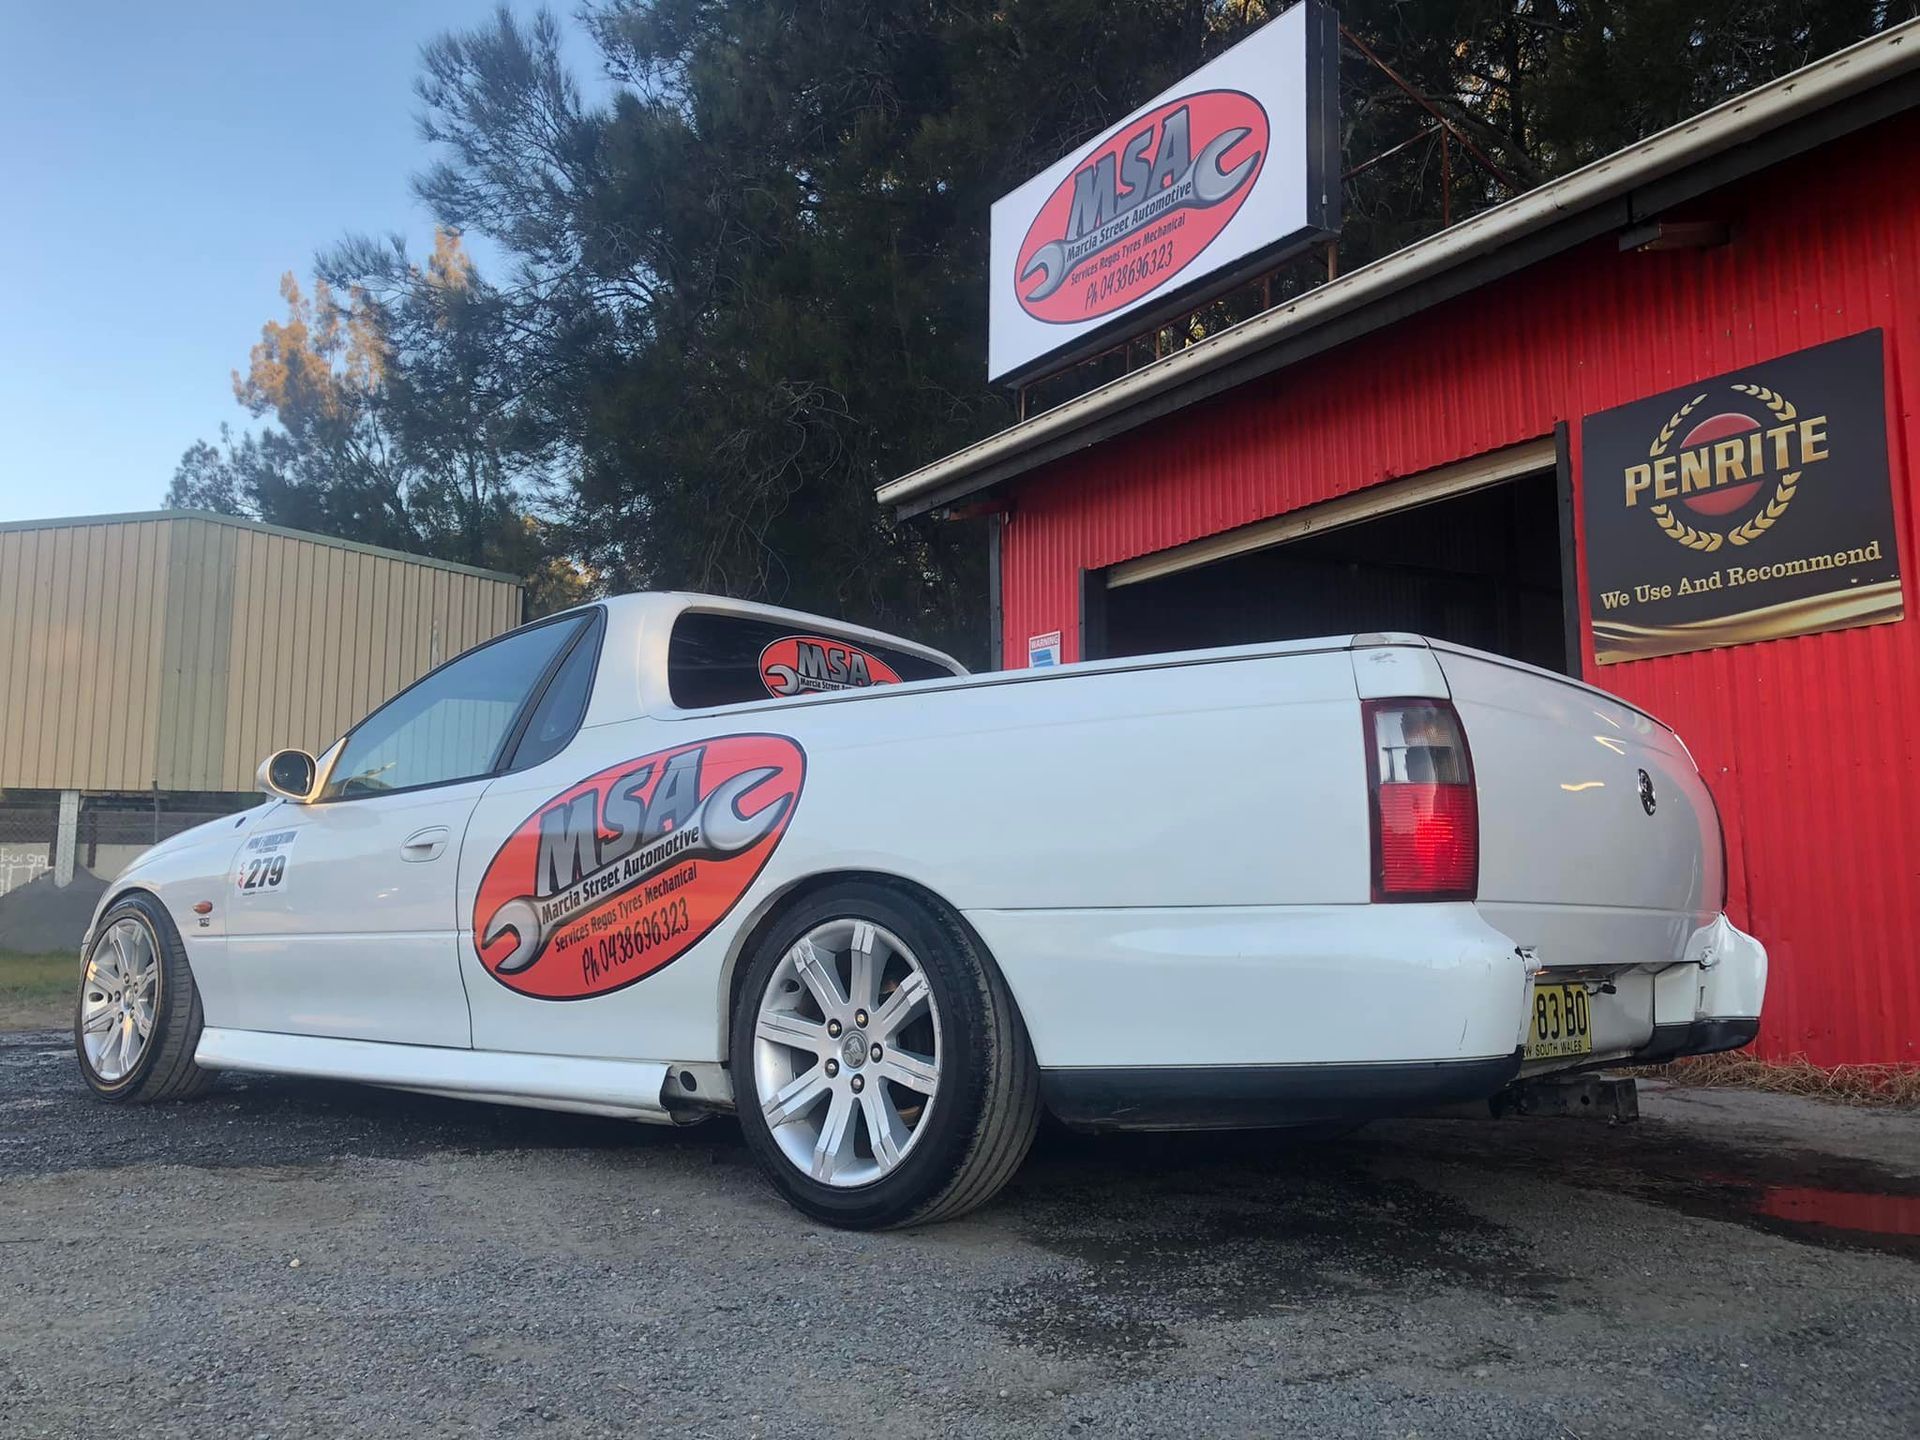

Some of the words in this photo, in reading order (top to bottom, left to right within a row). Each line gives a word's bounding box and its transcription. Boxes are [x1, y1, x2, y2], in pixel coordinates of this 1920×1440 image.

[1065, 105, 1191, 241] MSA
[1066, 234, 1097, 263] Marcia
[1100, 216, 1129, 243] Street
[1132, 181, 1191, 225] Automotive
[1071, 263, 1098, 286] Services
[1100, 251, 1120, 271] Regos
[1122, 239, 1141, 258] Tyres
[1143, 213, 1185, 245] Mechanical
[1084, 283, 1097, 310] Ph
[1100, 241, 1173, 300] 0438696323
[1625, 415, 1828, 507] PENRITE
[1600, 591, 1630, 610] We
[1634, 583, 1671, 603] Use
[1677, 572, 1722, 596] And
[1726, 541, 1882, 587] Recommend
[796, 640, 872, 687] MSA
[800, 677, 821, 688] Marcia
[536, 746, 707, 898] MSA
[244, 855, 286, 889] 279
[542, 891, 580, 925] Marcia
[583, 870, 620, 903] Street
[623, 826, 699, 878] Automotive
[556, 926, 589, 953] Services
[591, 910, 617, 935] Regos
[619, 895, 643, 918] Tyres
[645, 862, 697, 903] Mechanical
[582, 947, 600, 986] Ph
[600, 896, 689, 972] 0438696323
[1536, 1043, 1558, 1057] SOUTH
[1561, 1040, 1582, 1053] WALES
